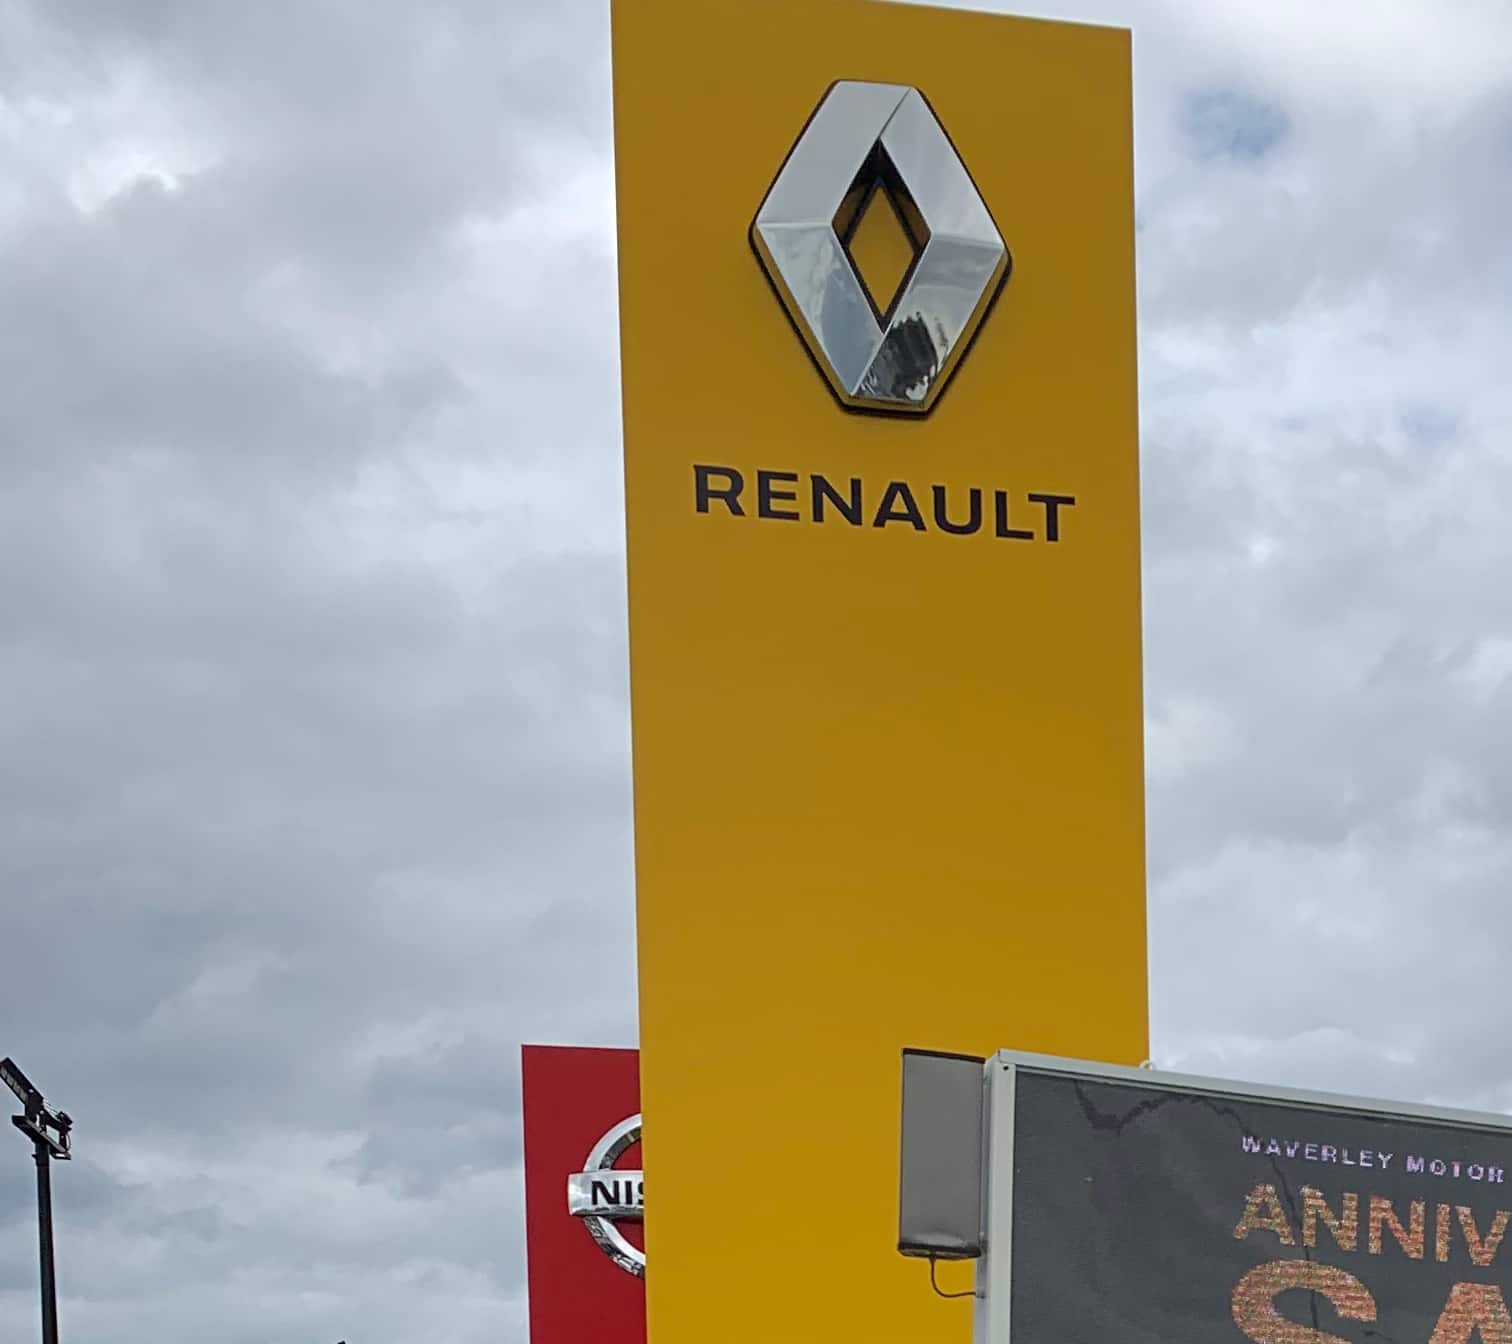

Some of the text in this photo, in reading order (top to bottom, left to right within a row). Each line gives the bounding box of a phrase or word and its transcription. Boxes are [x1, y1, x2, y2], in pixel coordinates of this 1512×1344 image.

[693, 464, 1076, 543] RENAULT
[1241, 1135, 1394, 1170] WAVERLEY
[1406, 1155, 1505, 1184] MOTOR
